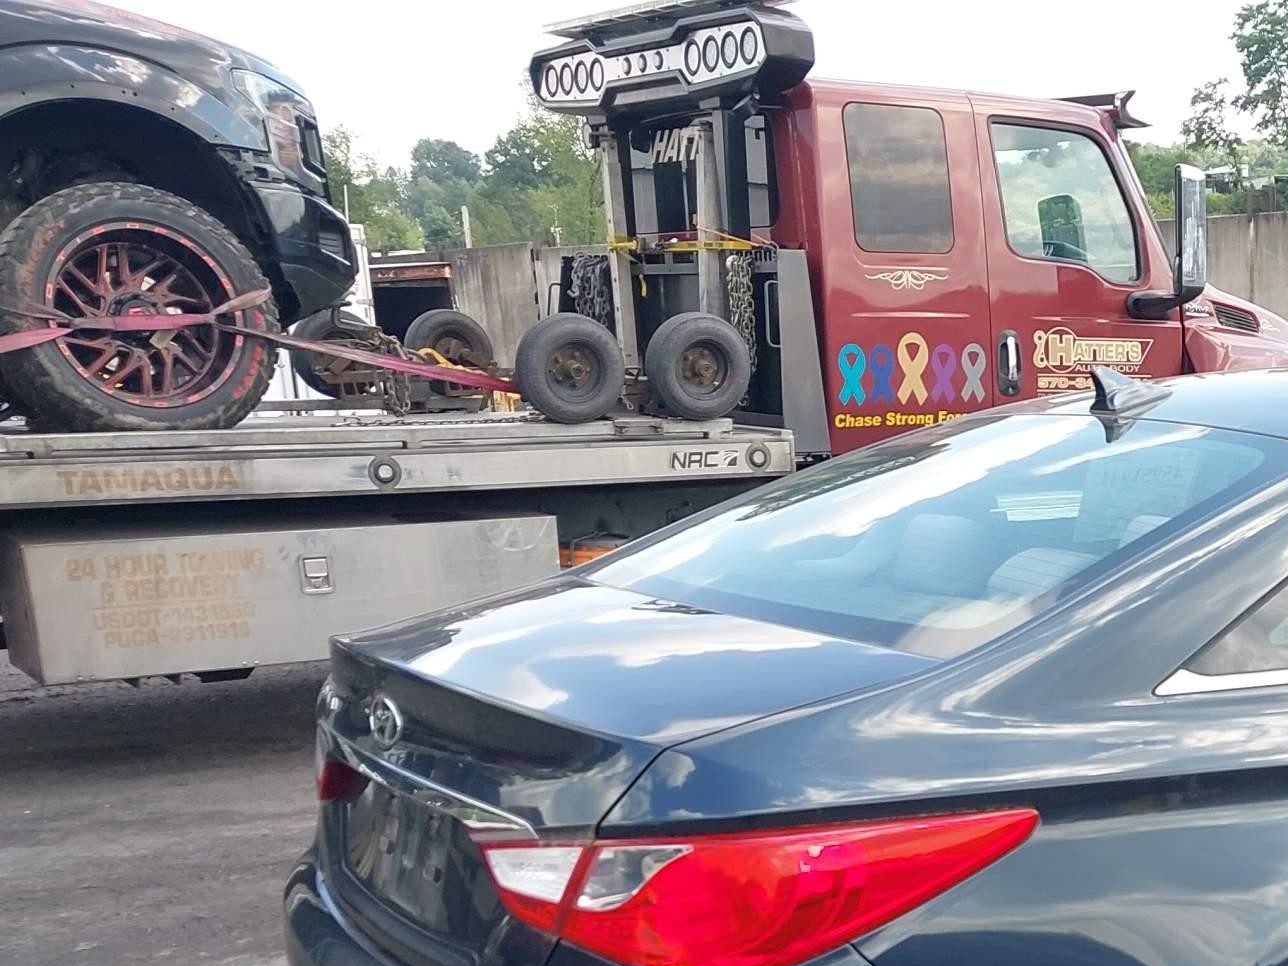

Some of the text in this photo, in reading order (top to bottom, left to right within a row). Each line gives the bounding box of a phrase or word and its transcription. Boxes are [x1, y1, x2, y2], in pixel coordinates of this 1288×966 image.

[1048, 333, 1142, 366] HATTER'S
[1110, 364, 1141, 373] BODY
[835, 413, 882, 428] Chase
[885, 411, 934, 427] Strong
[671, 451, 719, 469] NRC
[56, 464, 241, 495] TAMAQUA
[65, 558, 96, 581] 24
[104, 553, 168, 579] HOUR
[124, 573, 241, 601] RECOVERY
